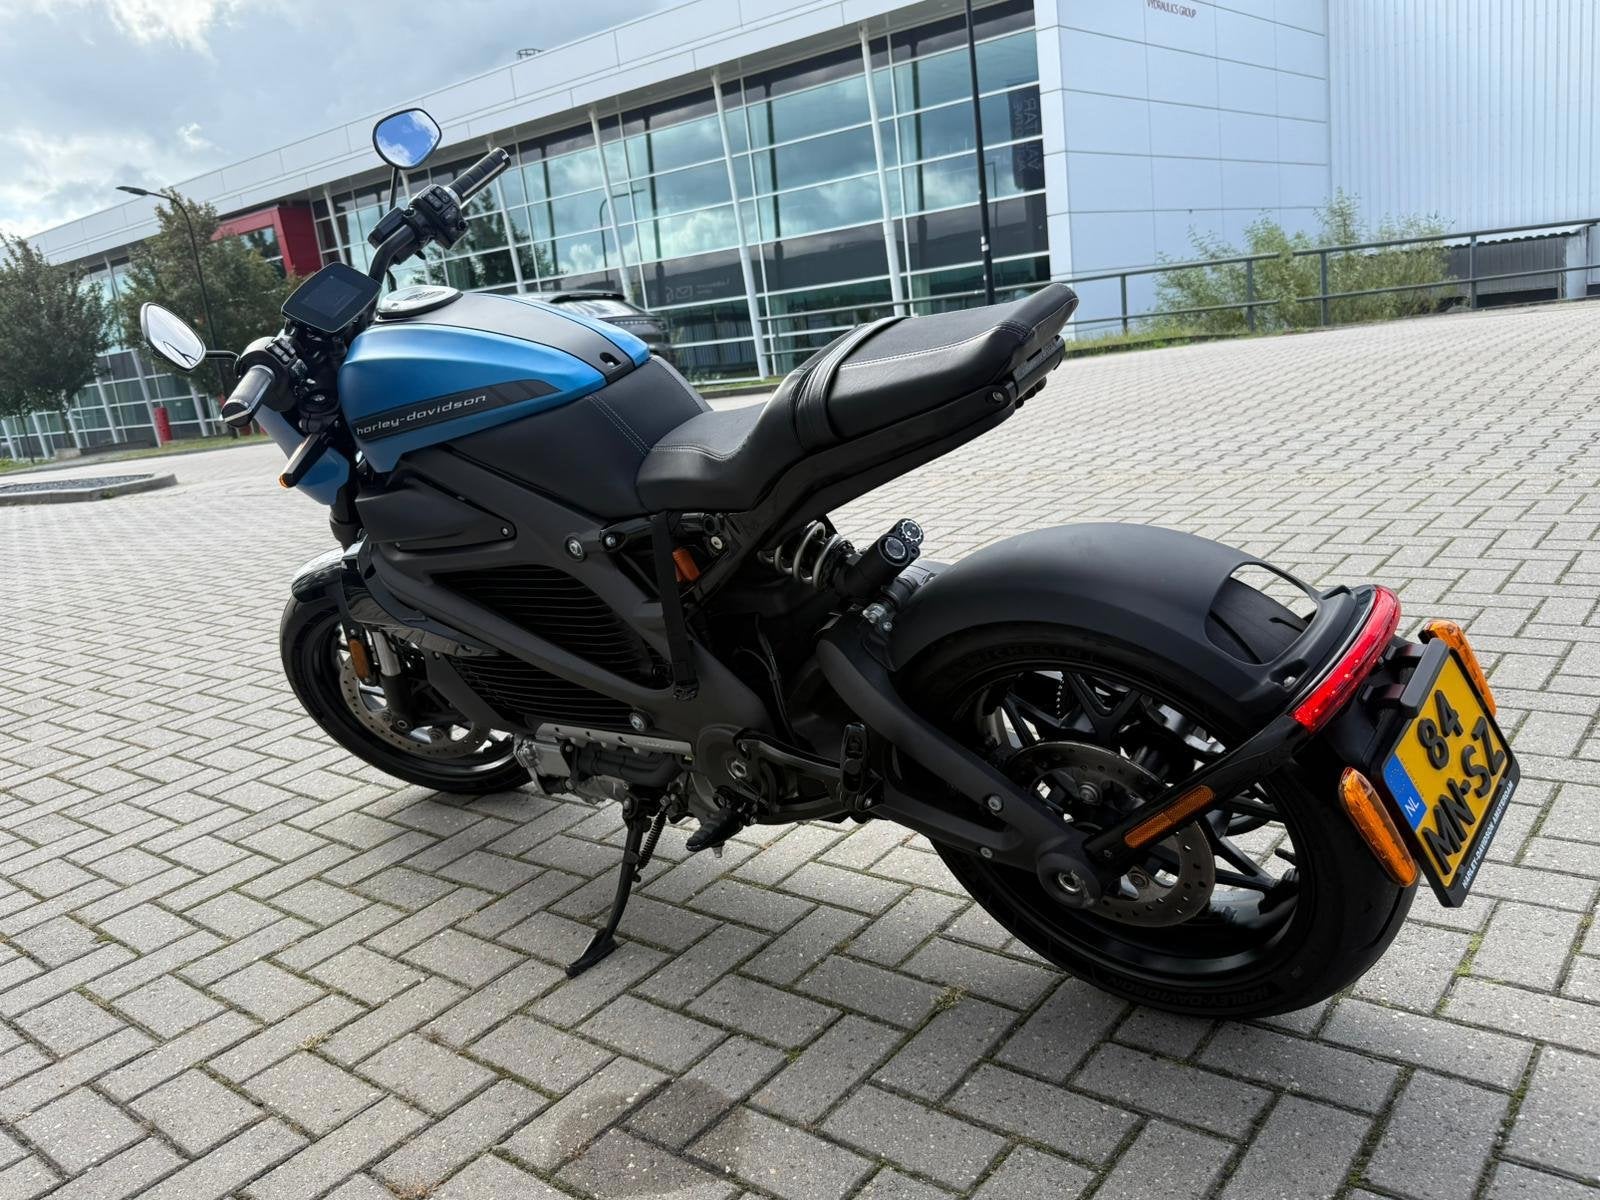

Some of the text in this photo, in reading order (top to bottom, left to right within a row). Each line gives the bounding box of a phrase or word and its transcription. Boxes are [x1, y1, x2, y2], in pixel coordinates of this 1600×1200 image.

[1179, 6, 1197, 18] GROUP
[356, 395, 486, 435] harley-davidson
[1417, 689, 1463, 770] 84
[1404, 796, 1420, 818] NL
[1421, 715, 1505, 876] MN-SZ
[1462, 780, 1514, 889] HARLEY-DAVIDSON AMSTERDAM
